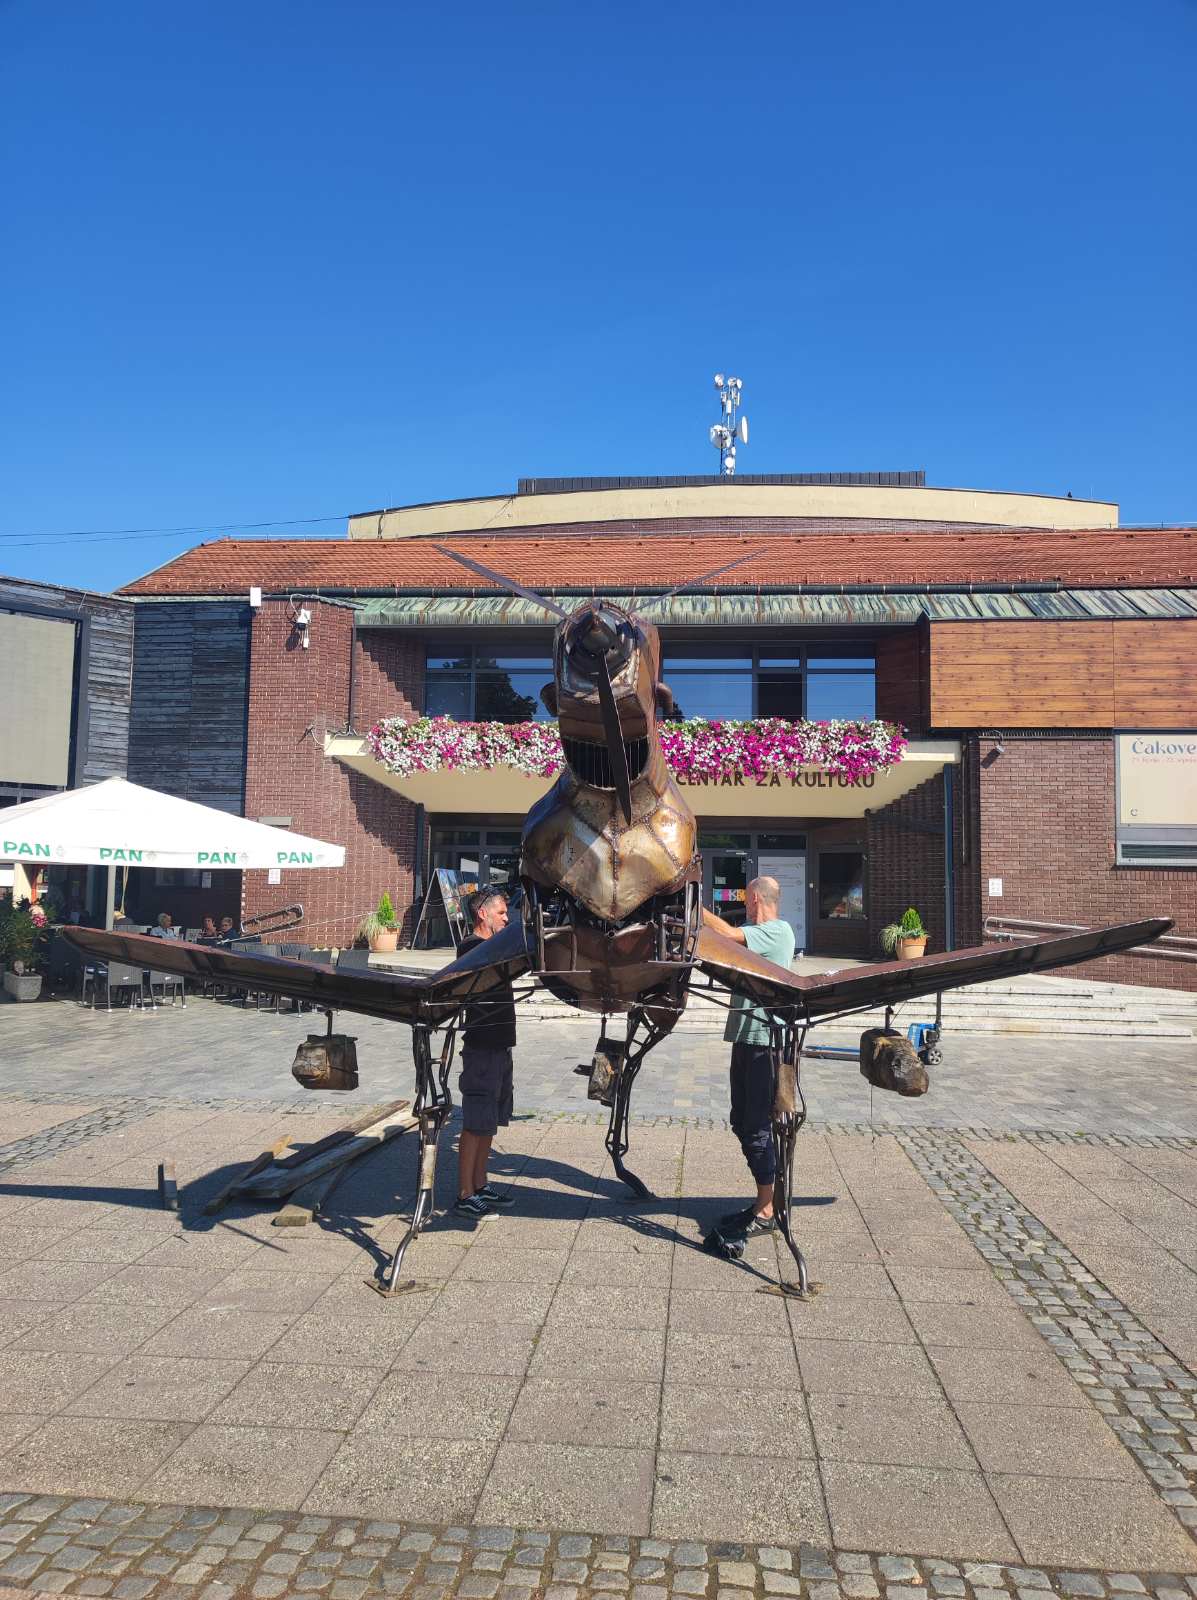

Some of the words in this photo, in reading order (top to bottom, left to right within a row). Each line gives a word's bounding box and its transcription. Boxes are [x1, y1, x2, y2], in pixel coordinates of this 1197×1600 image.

[756, 771, 781, 787] ZA
[3, 840, 51, 857] PAN
[100, 848, 143, 862] PAN
[197, 852, 236, 864] PAN
[277, 852, 313, 863] PAN
